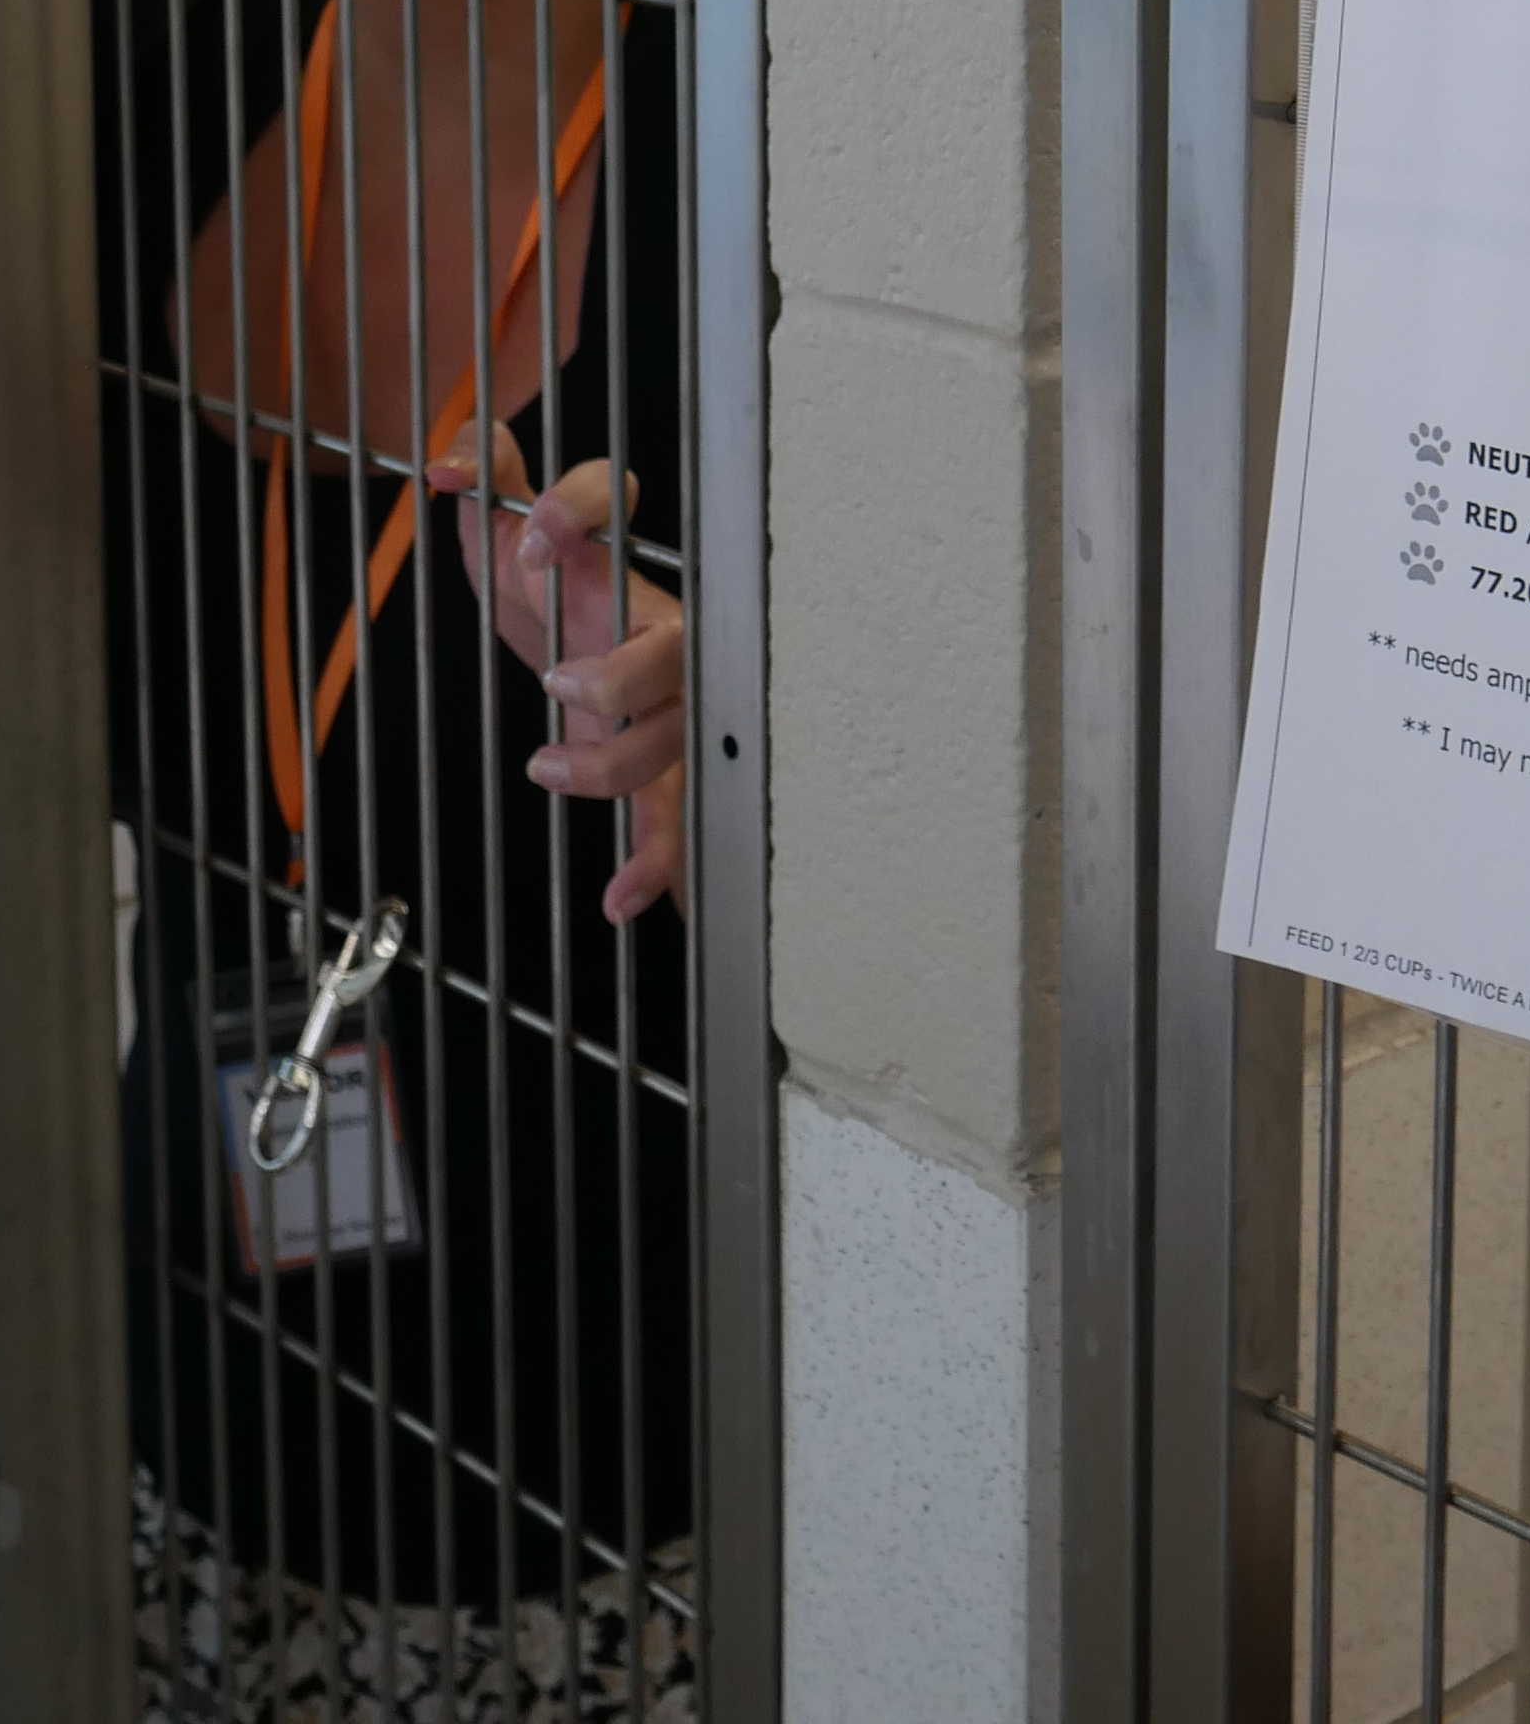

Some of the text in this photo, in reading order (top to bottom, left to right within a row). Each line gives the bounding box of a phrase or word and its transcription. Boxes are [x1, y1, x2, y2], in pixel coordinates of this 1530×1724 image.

[1464, 500, 1518, 535] RED
[1405, 645, 1479, 683] needs
[1439, 726, 1452, 752] I
[1460, 737, 1513, 773] may
[1285, 925, 1334, 953] FEED
[1340, 941, 1348, 957] 1
[1353, 945, 1379, 967] 2/3
[1384, 954, 1433, 982] CUPs
[1449, 971, 1509, 1005] TWICE
[1512, 990, 1525, 1008] A
